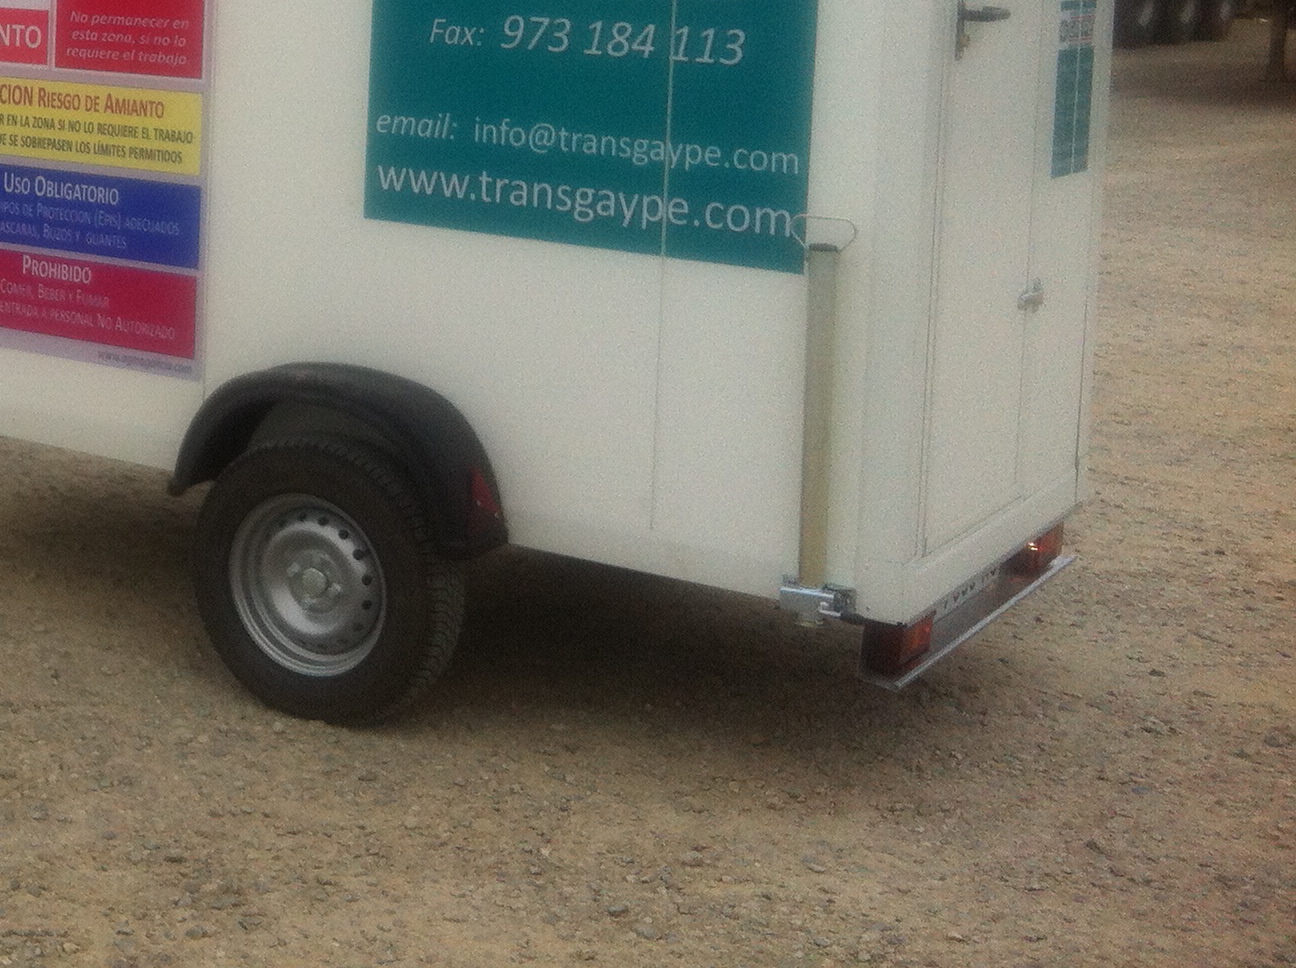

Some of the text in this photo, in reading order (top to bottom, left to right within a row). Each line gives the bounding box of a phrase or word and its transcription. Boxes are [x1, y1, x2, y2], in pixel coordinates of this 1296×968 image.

[70, 10, 189, 30] No permanecer en
[71, 29, 98, 42] esta
[154, 36, 170, 46] no
[175, 34, 187, 48] lo
[429, 15, 747, 66] Fax: 973 184 113
[66, 46, 187, 66] requiere el trabajo
[37, 87, 81, 110] RIESGO
[85, 95, 100, 112] DE
[104, 93, 165, 118] AMIANTO
[6, 114, 18, 127] EN
[19, 115, 31, 128] LA
[32, 116, 55, 130] ZONA
[68, 120, 81, 133] NO
[84, 121, 95, 134] LO
[96, 122, 138, 138] REQUIERE
[141, 126, 151, 140] EL
[153, 127, 194, 144] TRABAJO
[375, 111, 800, 175] email: info@transgaype.com
[9, 134, 19, 148] SE
[20, 136, 73, 153] SOBREPASEN
[75, 141, 91, 154] LOS
[128, 146, 183, 164] PERMITIDOS
[4, 171, 119, 205] USO OBLIGATORIO
[376, 165, 793, 238] www.transgaype.com
[23, 204, 33, 218] DE
[85, 232, 126, 249] GUANTES
[22, 254, 92, 284] PROHIBIDO
[37, 283, 65, 302] BEBER
[76, 288, 110, 308] FUMAR
[97, 313, 113, 330] NO
